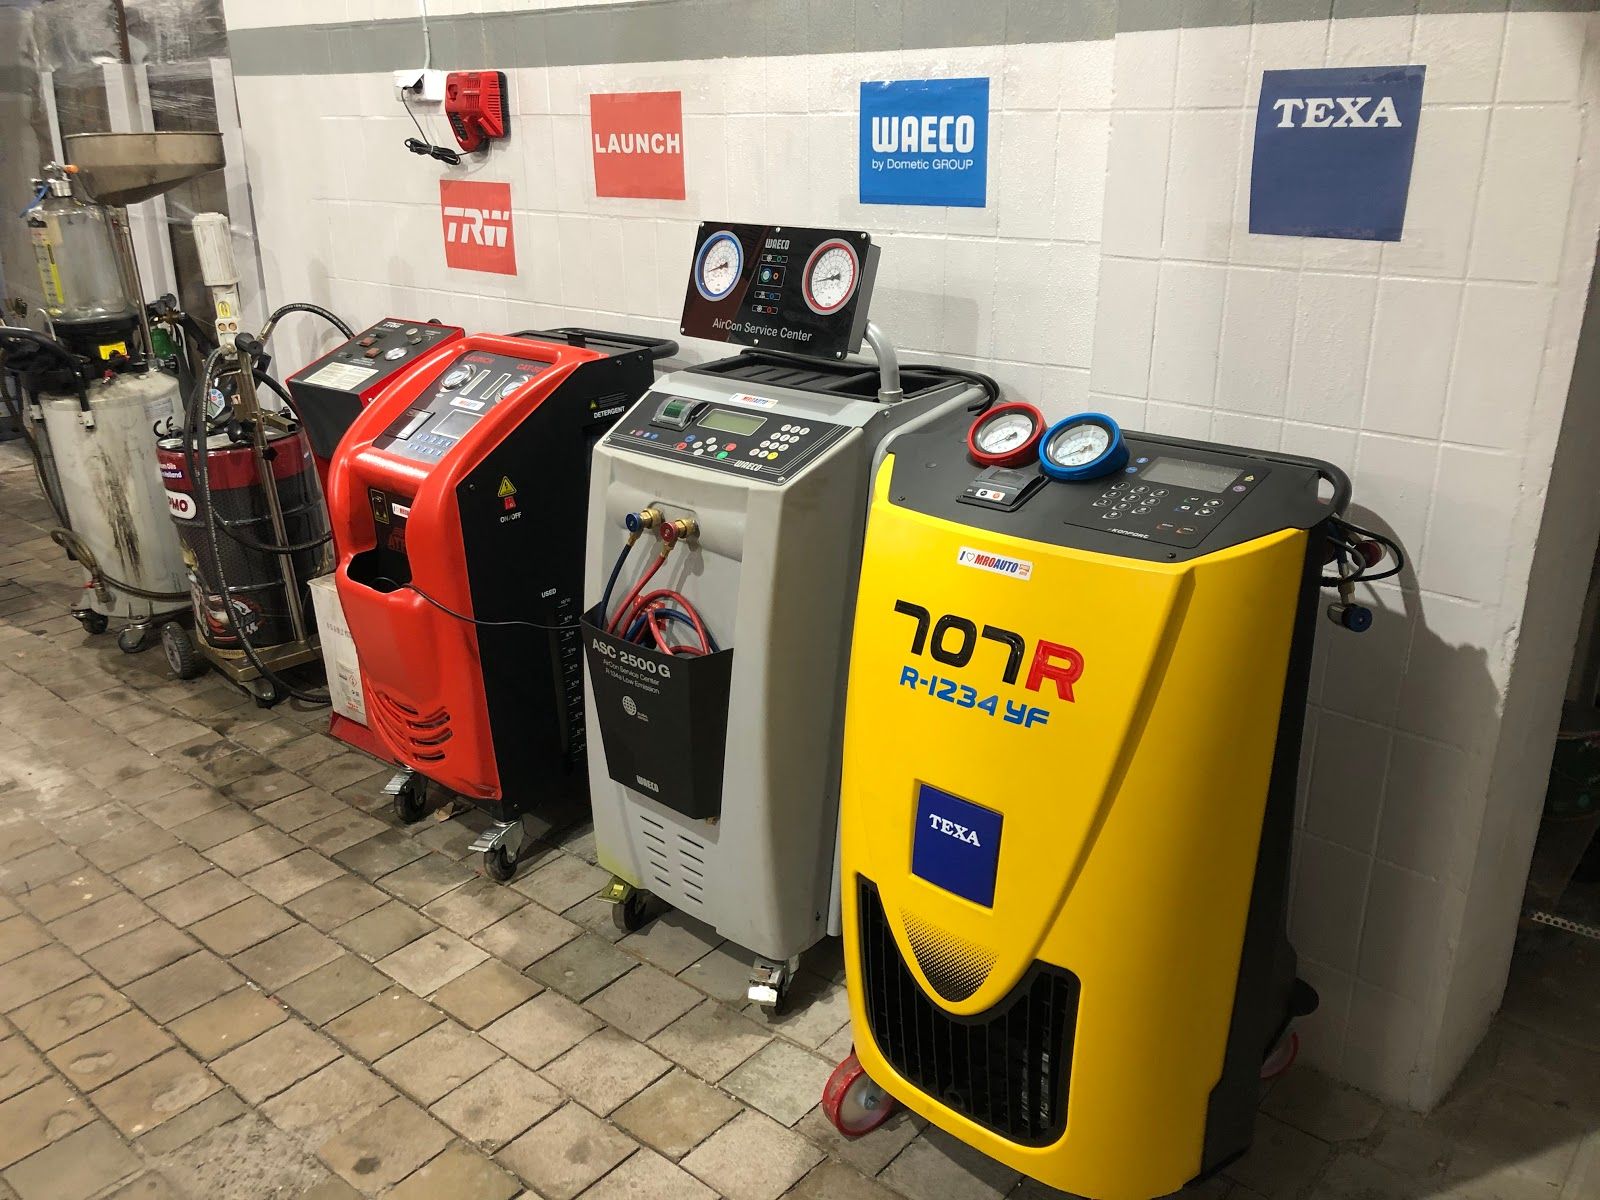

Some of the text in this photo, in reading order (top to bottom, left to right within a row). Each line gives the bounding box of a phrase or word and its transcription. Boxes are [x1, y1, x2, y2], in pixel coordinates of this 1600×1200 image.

[1272, 96, 1402, 128] TEXA
[594, 132, 680, 154] LAUNCH
[871, 114, 975, 153] WAECO
[871, 159, 974, 171] by Dometic GROUP
[443, 206, 510, 248] TRW
[765, 238, 791, 250] WAECO
[712, 317, 813, 342] AirCon Service Center
[593, 405, 626, 419] DETERGENT
[733, 459, 763, 472] WAECO
[959, 550, 1019, 573] I MROAUTO
[541, 587, 557, 598] USED
[592, 638, 616, 659] ASC
[619, 650, 657, 674] 2500
[894, 599, 1085, 703] 707R
[900, 665, 999, 717] R-1234
[636, 774, 660, 793] WAECO
[929, 813, 981, 847] TEXA
